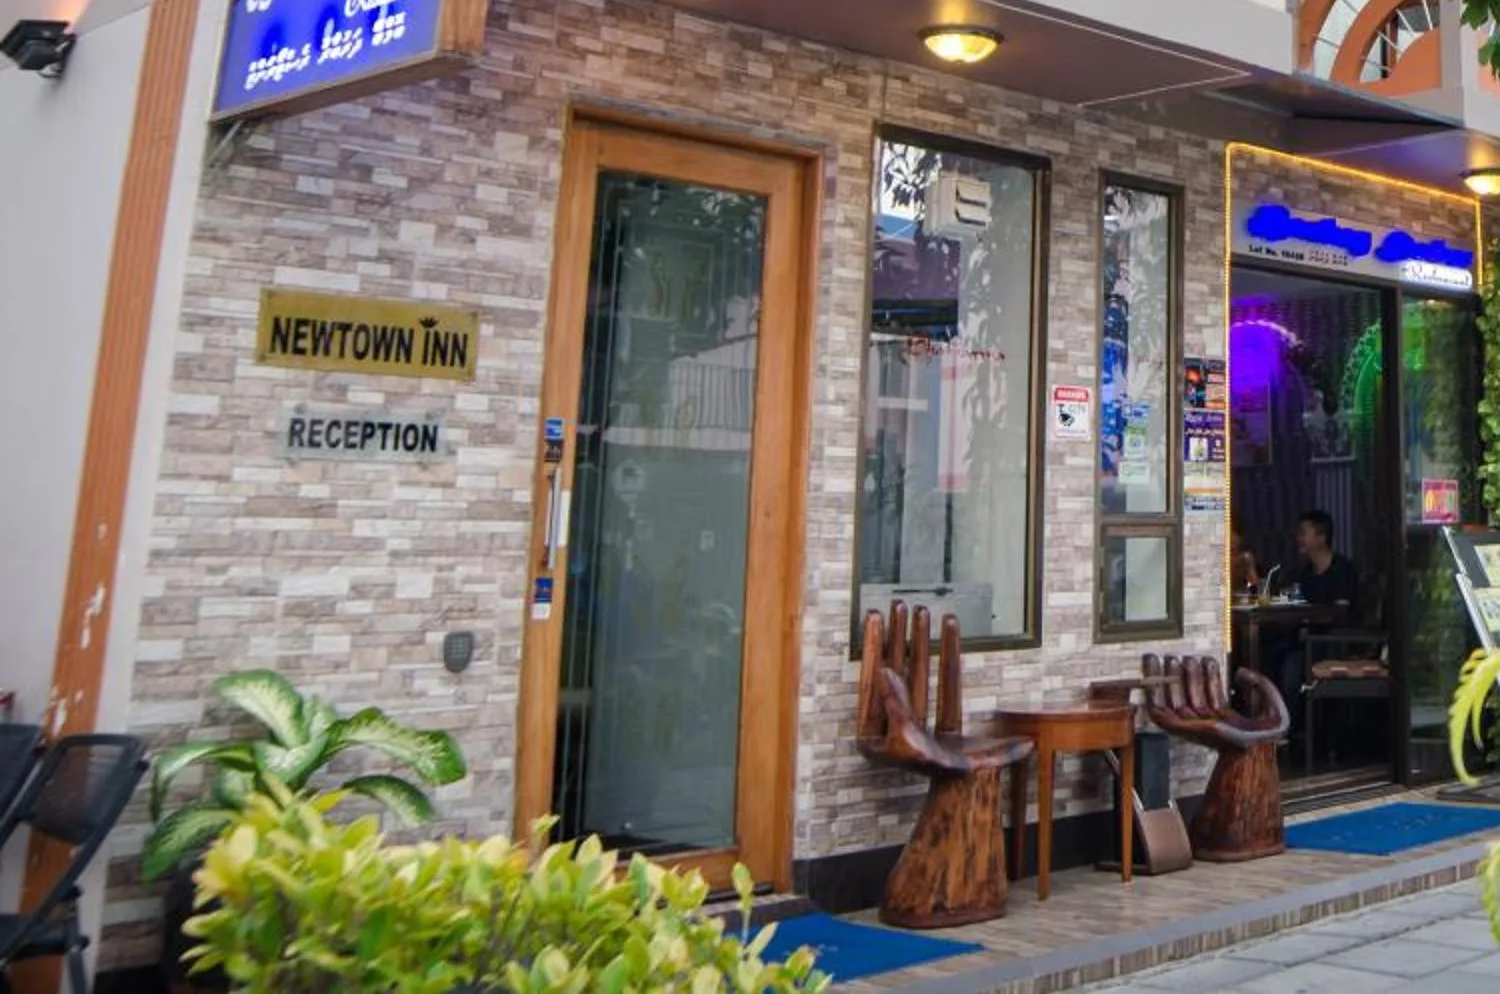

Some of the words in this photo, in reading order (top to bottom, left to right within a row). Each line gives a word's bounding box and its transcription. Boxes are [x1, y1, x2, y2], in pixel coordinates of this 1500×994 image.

[269, 316, 414, 364] NEWTOWN
[420, 318, 469, 368] INN
[287, 417, 438, 452] RECEPTION
